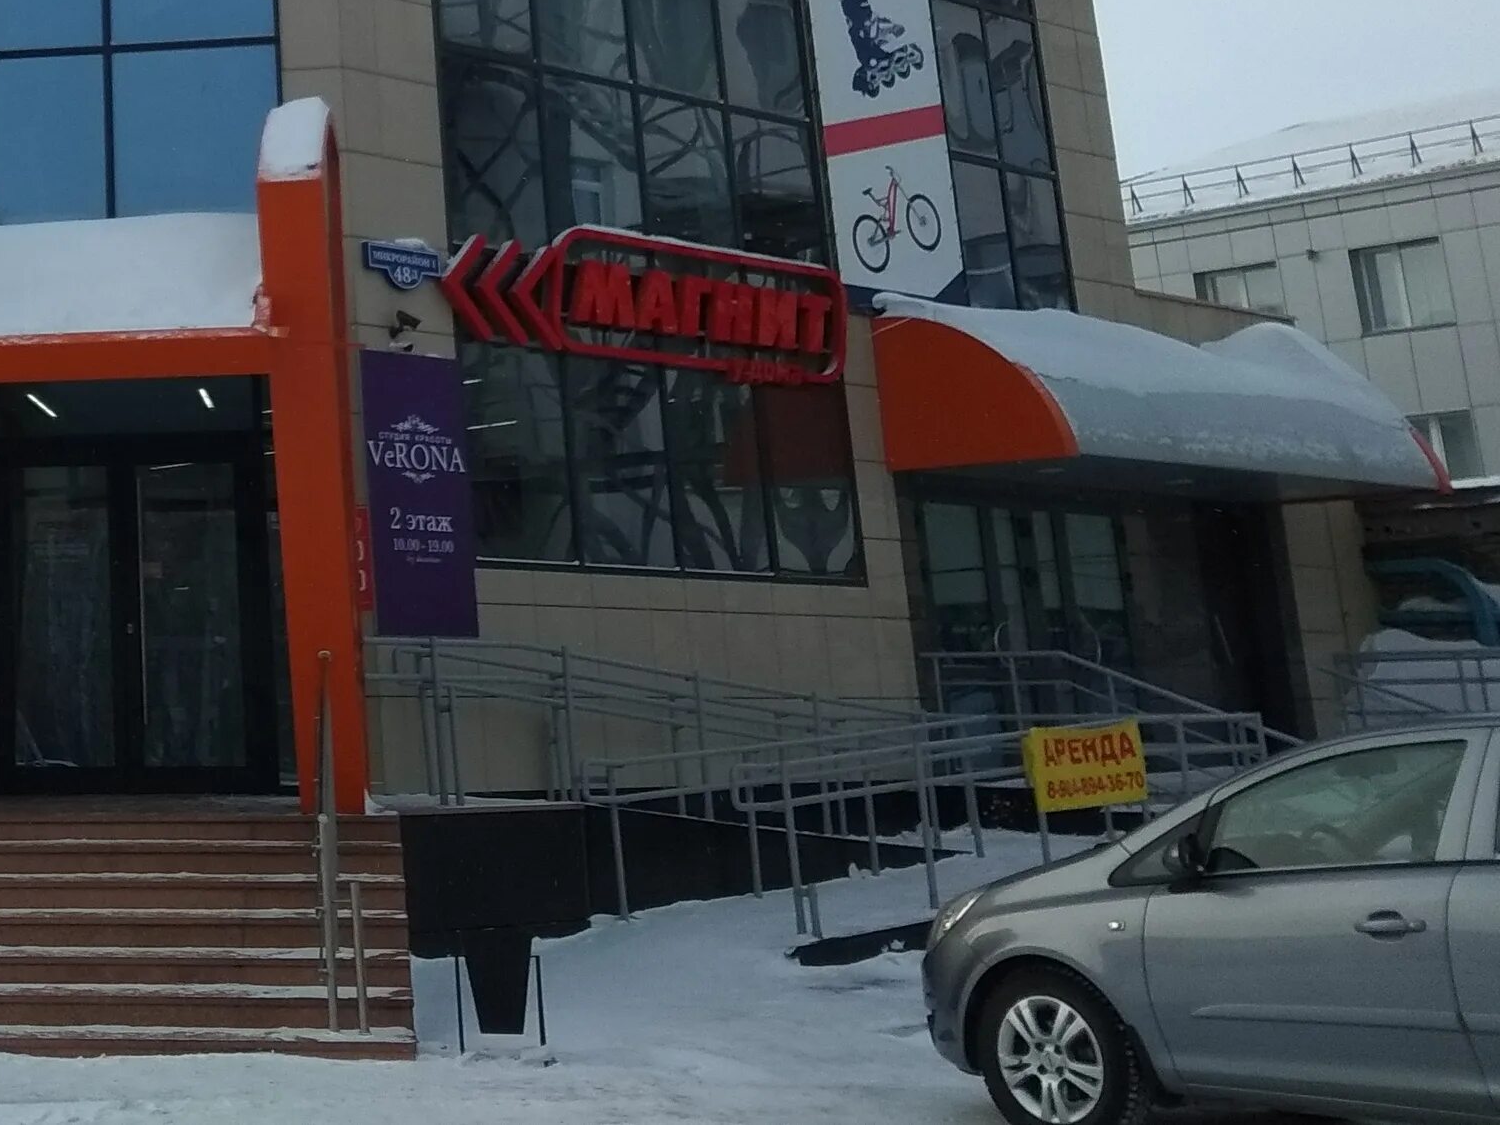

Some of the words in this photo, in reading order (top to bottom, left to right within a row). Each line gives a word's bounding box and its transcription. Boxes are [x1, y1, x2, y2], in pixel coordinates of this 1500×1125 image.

[570, 259, 833, 353] МАГНИТ
[389, 506, 401, 530] 2
[405, 514, 454, 533] этаж
[1043, 732, 1136, 767] АРЕНДА
